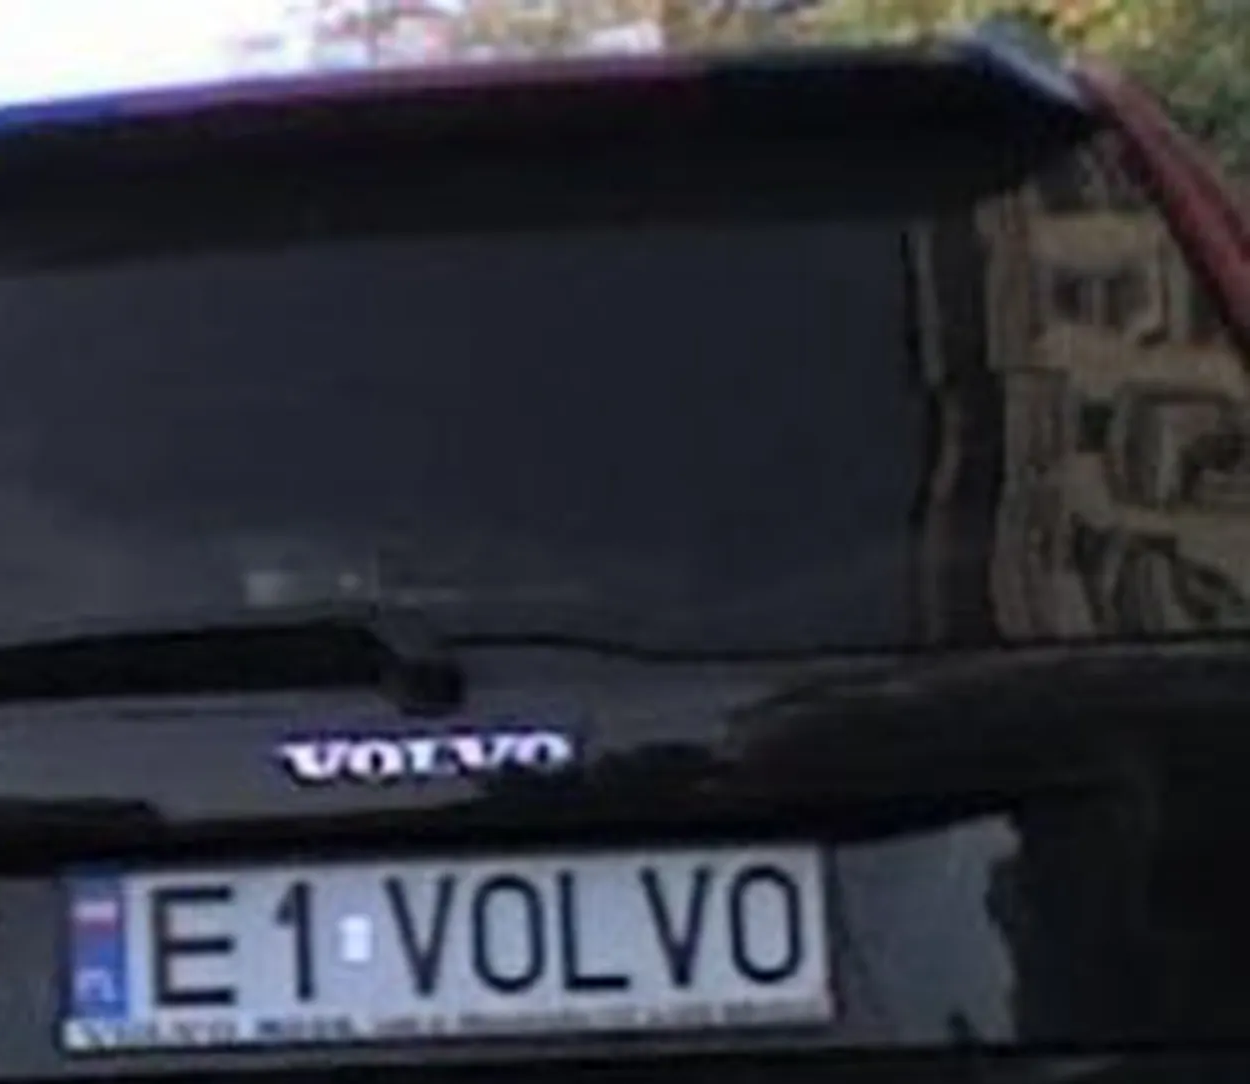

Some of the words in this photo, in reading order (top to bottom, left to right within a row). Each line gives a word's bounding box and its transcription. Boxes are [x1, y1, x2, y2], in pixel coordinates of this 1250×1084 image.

[280, 732, 570, 780] VOLVO
[152, 881, 314, 1006] E1
[383, 864, 801, 996] VOLVO
